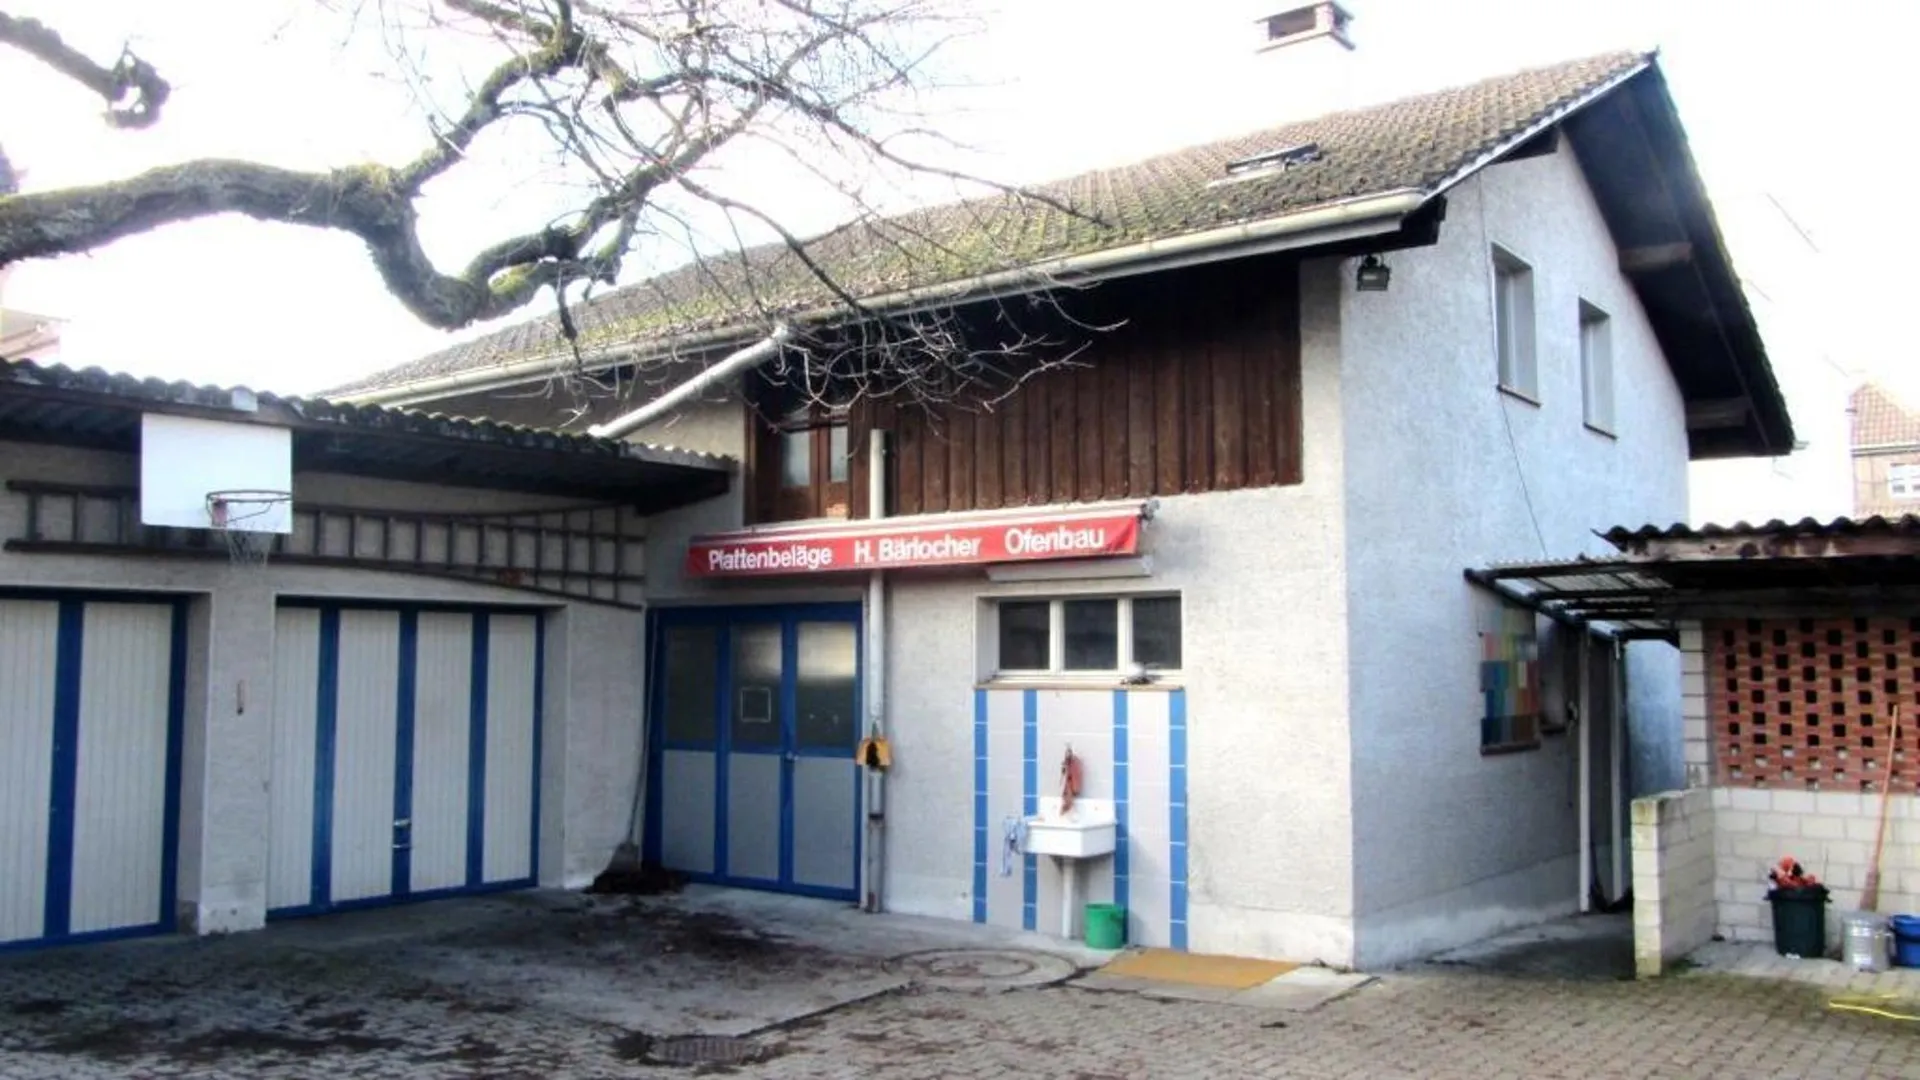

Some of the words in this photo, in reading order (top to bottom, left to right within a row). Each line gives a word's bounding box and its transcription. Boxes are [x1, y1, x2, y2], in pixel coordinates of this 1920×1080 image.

[708, 545, 833, 570] Plattenbeläge
[854, 539, 874, 563] H.
[879, 536, 981, 561] Bärlocher
[1004, 525, 1105, 554] Ofenbau
